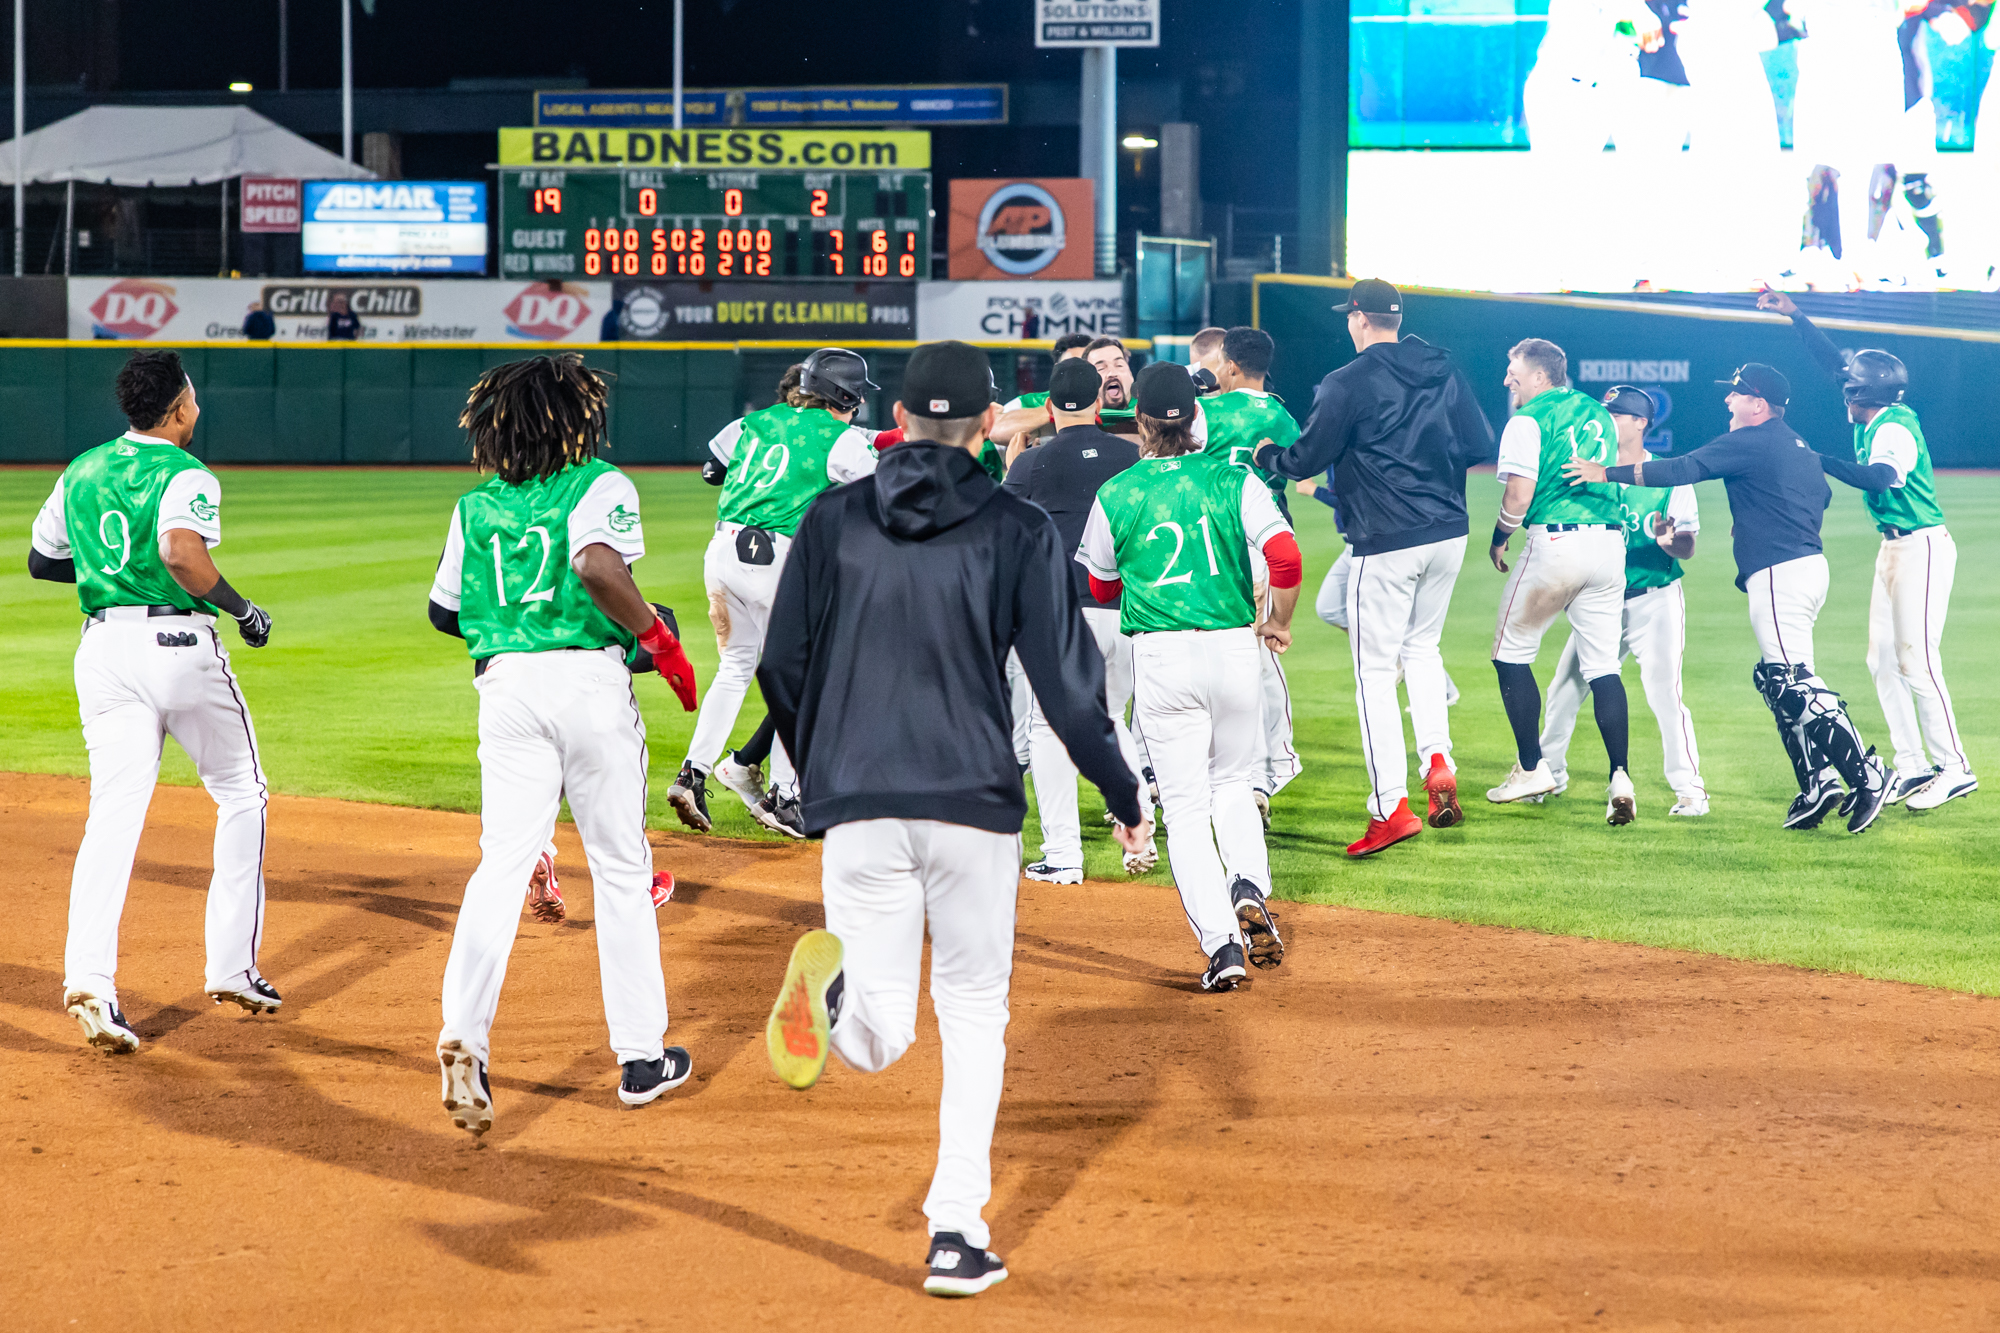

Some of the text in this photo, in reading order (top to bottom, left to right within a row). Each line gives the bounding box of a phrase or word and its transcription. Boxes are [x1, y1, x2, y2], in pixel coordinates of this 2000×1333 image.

[1043, 5, 1146, 18] SOLUTIONS
[531, 131, 897, 166] BALDNESS.com
[539, 171, 565, 188] BAT
[628, 171, 665, 189] BALL
[707, 172, 759, 190] STRIKE
[803, 172, 832, 190] OUT
[246, 183, 296, 201] PITCH
[318, 184, 437, 209] ADMAR
[534, 187, 562, 214] 19
[639, 188, 657, 216] 0
[724, 188, 743, 216] 0
[810, 189, 829, 217] 2
[244, 206, 298, 224] SPEED
[512, 229, 567, 249] GUEST
[829, 229, 844, 252] 7
[871, 229, 888, 253] 6
[906, 231, 915, 252] 1
[504, 254, 575, 272] RED WINGS
[829, 253, 844, 275] 7
[863, 253, 888, 277] 10
[899, 253, 915, 277] 0
[103, 292, 167, 326] DQ
[269, 288, 413, 314] Grill Chill
[516, 294, 576, 326] DQ
[674, 301, 910, 324] YOUR DUCT CLEANING PROS
[987, 297, 1042, 311] FOUR
[403, 322, 477, 339] Webster
[981, 313, 1122, 335] CHMNE
[1579, 360, 1690, 382] ROBINSON
[1567, 419, 1608, 464] 13
[738, 437, 790, 489] 19
[98, 509, 131, 576] 9
[1145, 514, 1221, 588] 21
[488, 525, 555, 607] 12
